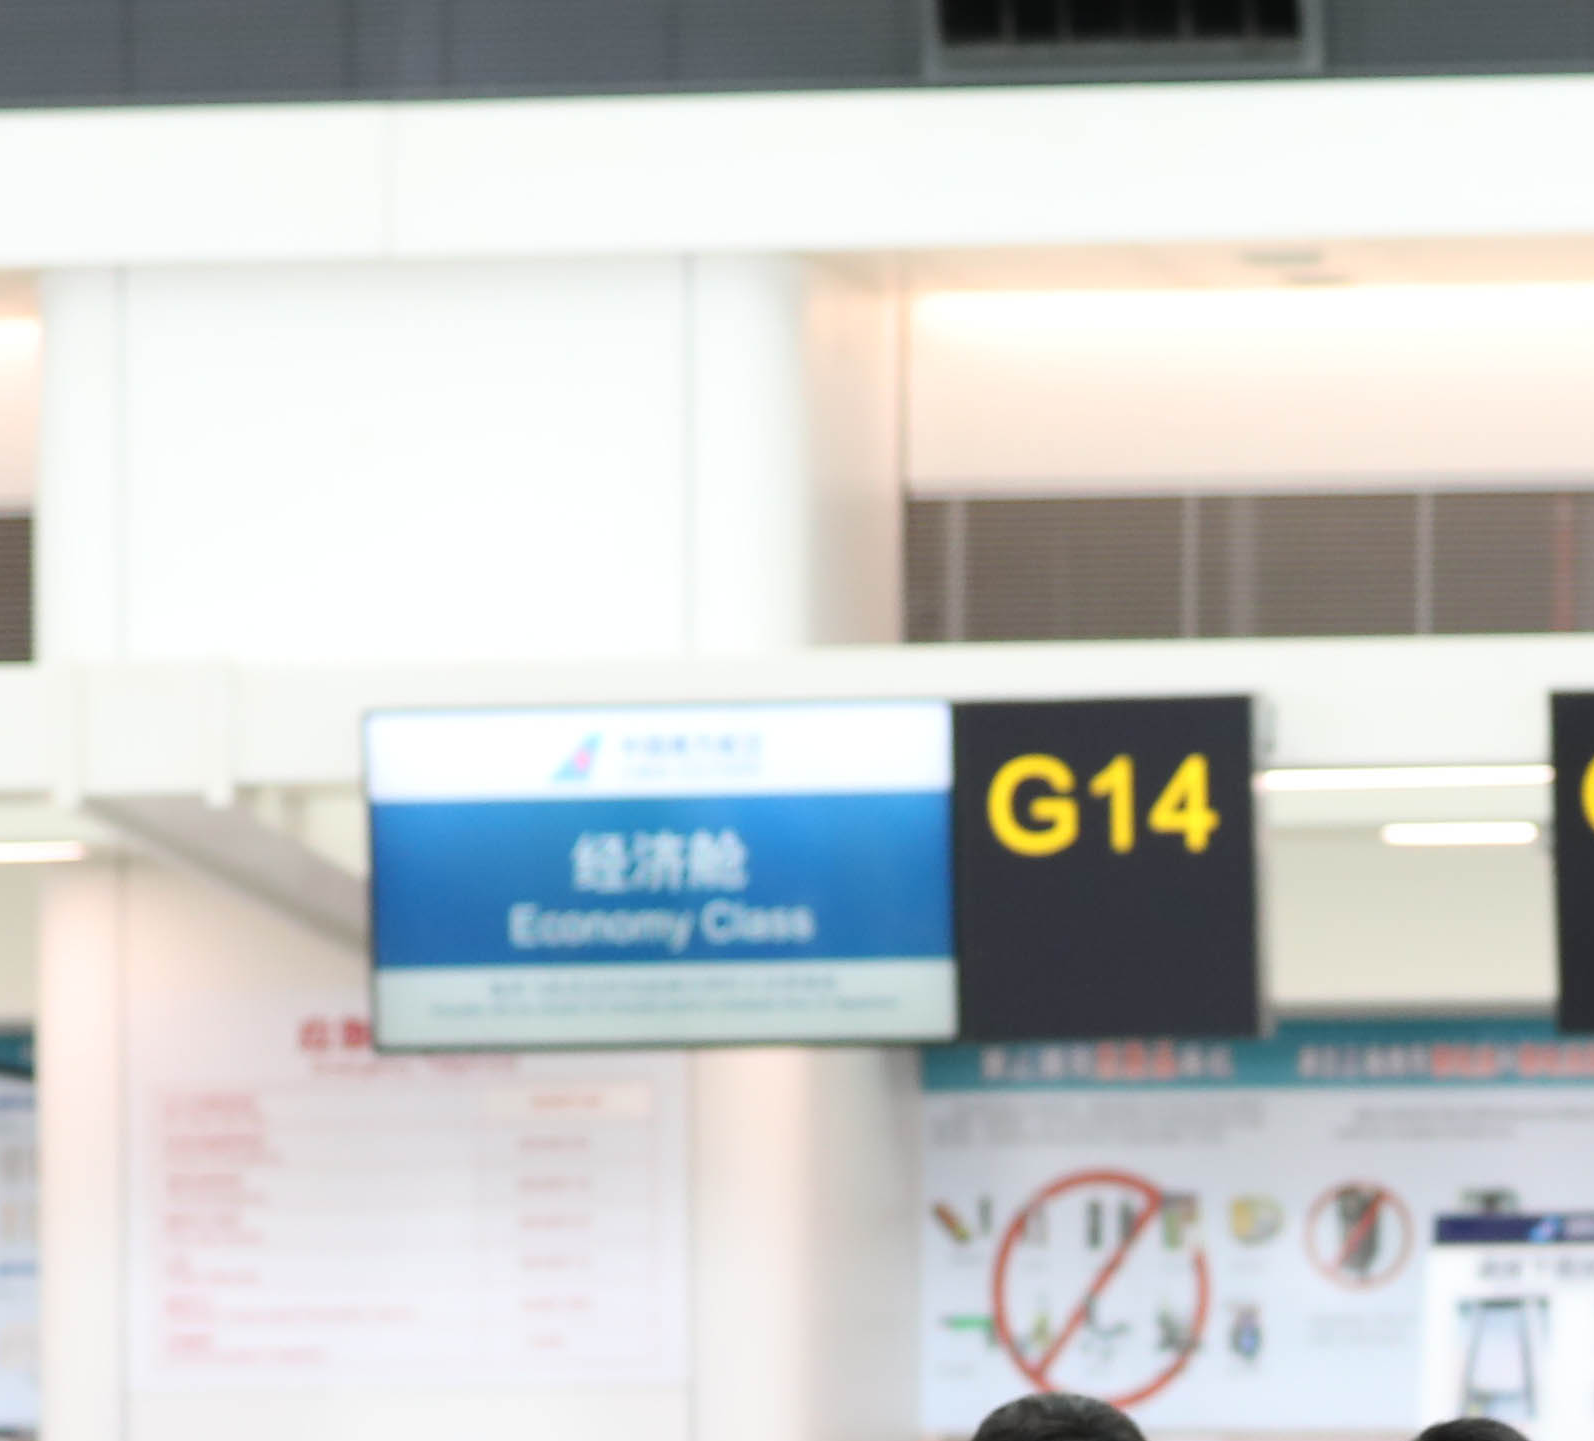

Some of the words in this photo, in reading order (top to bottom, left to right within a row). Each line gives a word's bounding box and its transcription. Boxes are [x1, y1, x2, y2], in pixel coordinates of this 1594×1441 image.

[987, 753, 1218, 856] G14
[571, 828, 748, 893] 经济舱
[508, 903, 690, 952] Economy
[700, 899, 816, 945] Class
